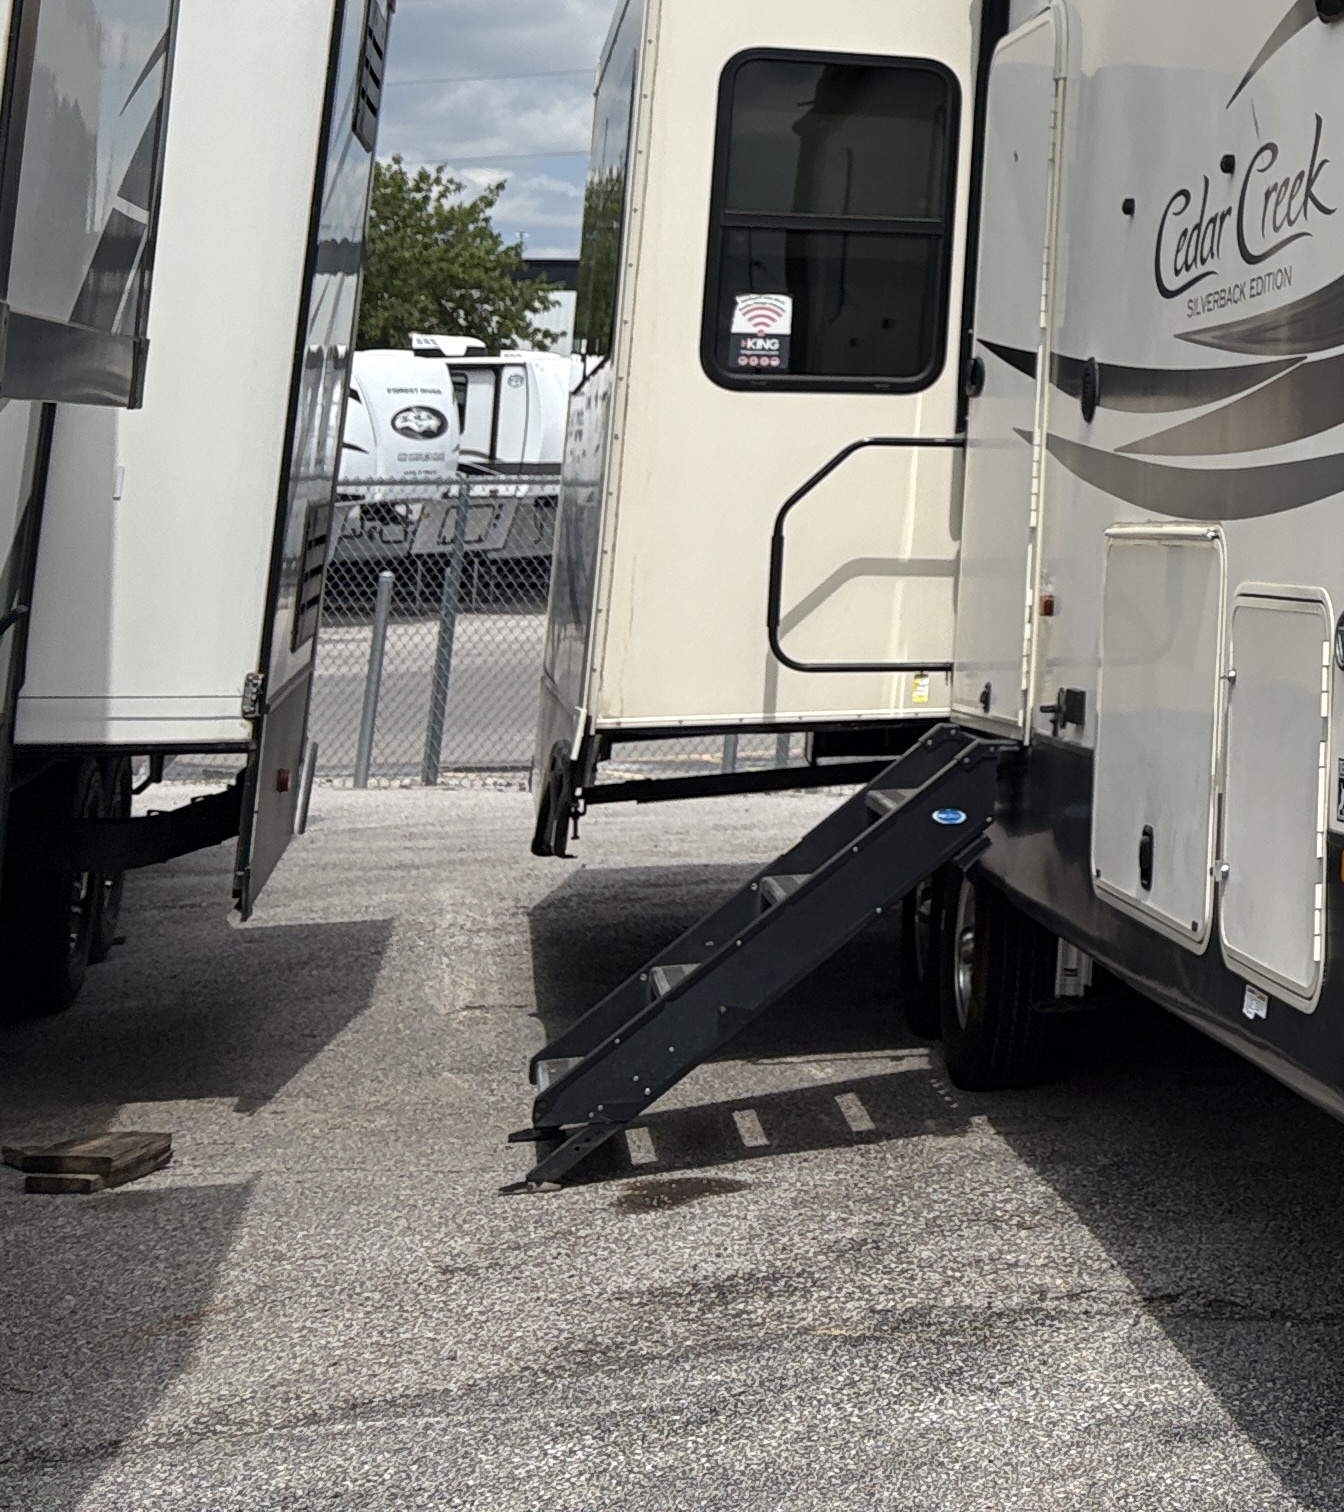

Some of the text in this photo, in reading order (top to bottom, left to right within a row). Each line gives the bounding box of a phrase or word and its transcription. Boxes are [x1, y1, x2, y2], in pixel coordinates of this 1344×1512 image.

[1154, 111, 1338, 300] Cedar Creek
[1186, 265, 1293, 319] SILVERBACK EDITION
[747, 337, 780, 350] KING
